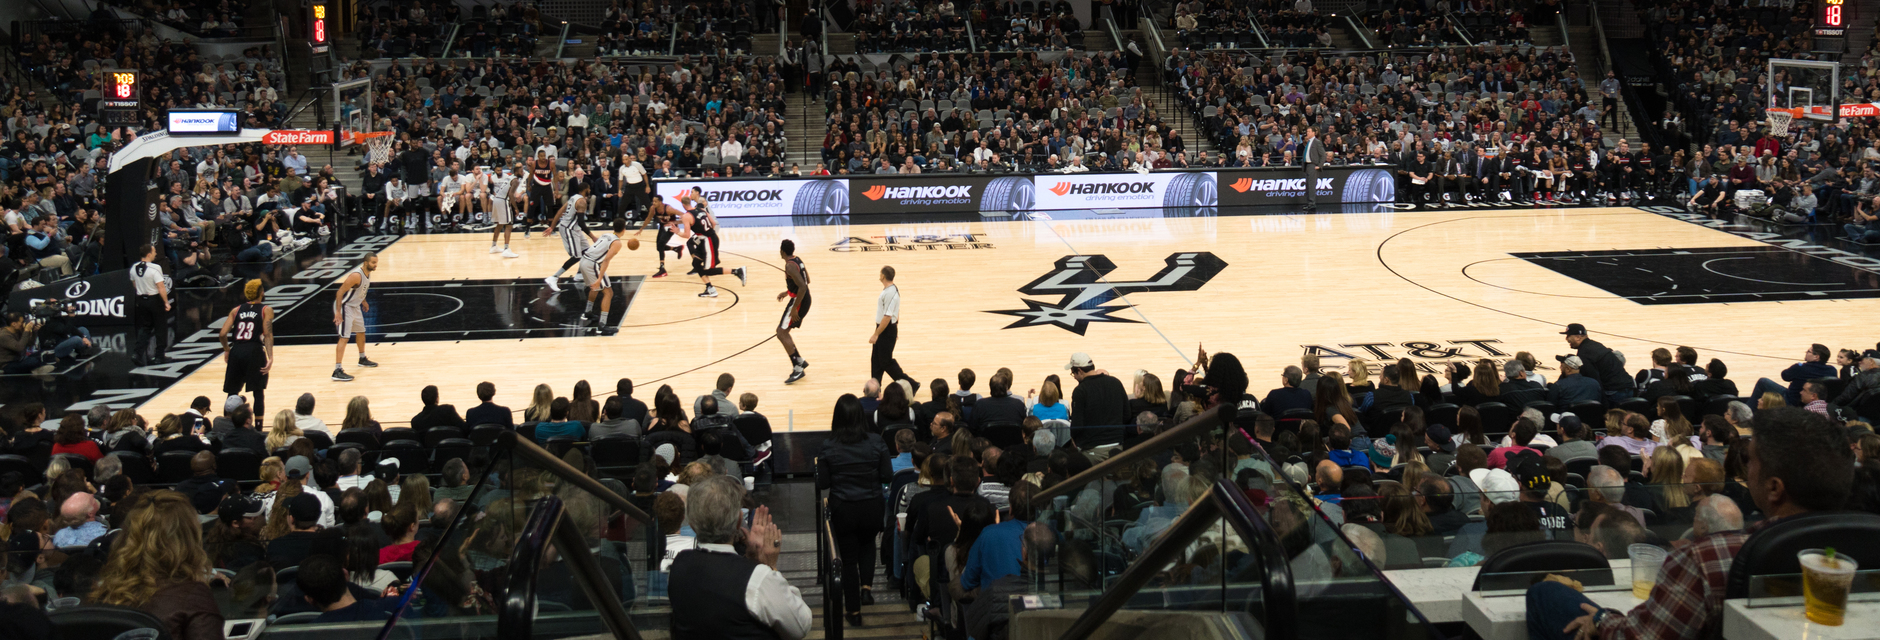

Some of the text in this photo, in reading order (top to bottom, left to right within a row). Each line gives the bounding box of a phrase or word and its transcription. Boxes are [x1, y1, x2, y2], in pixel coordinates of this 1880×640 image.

[1826, 5, 1841, 26] 18
[314, 19, 325, 42] 18
[113, 73, 135, 85] 7:03
[117, 84, 131, 98] 18
[1850, 105, 1875, 116] Farm
[270, 132, 329, 144] State Farm
[1265, 190, 1296, 198] driving
[899, 198, 932, 206] driving
[831, 233, 987, 246] AT&T
[828, 243, 997, 253] CENTER
[291, 234, 401, 279] SPURS
[236, 321, 255, 341] 23
[1300, 338, 1512, 362] AT&T
